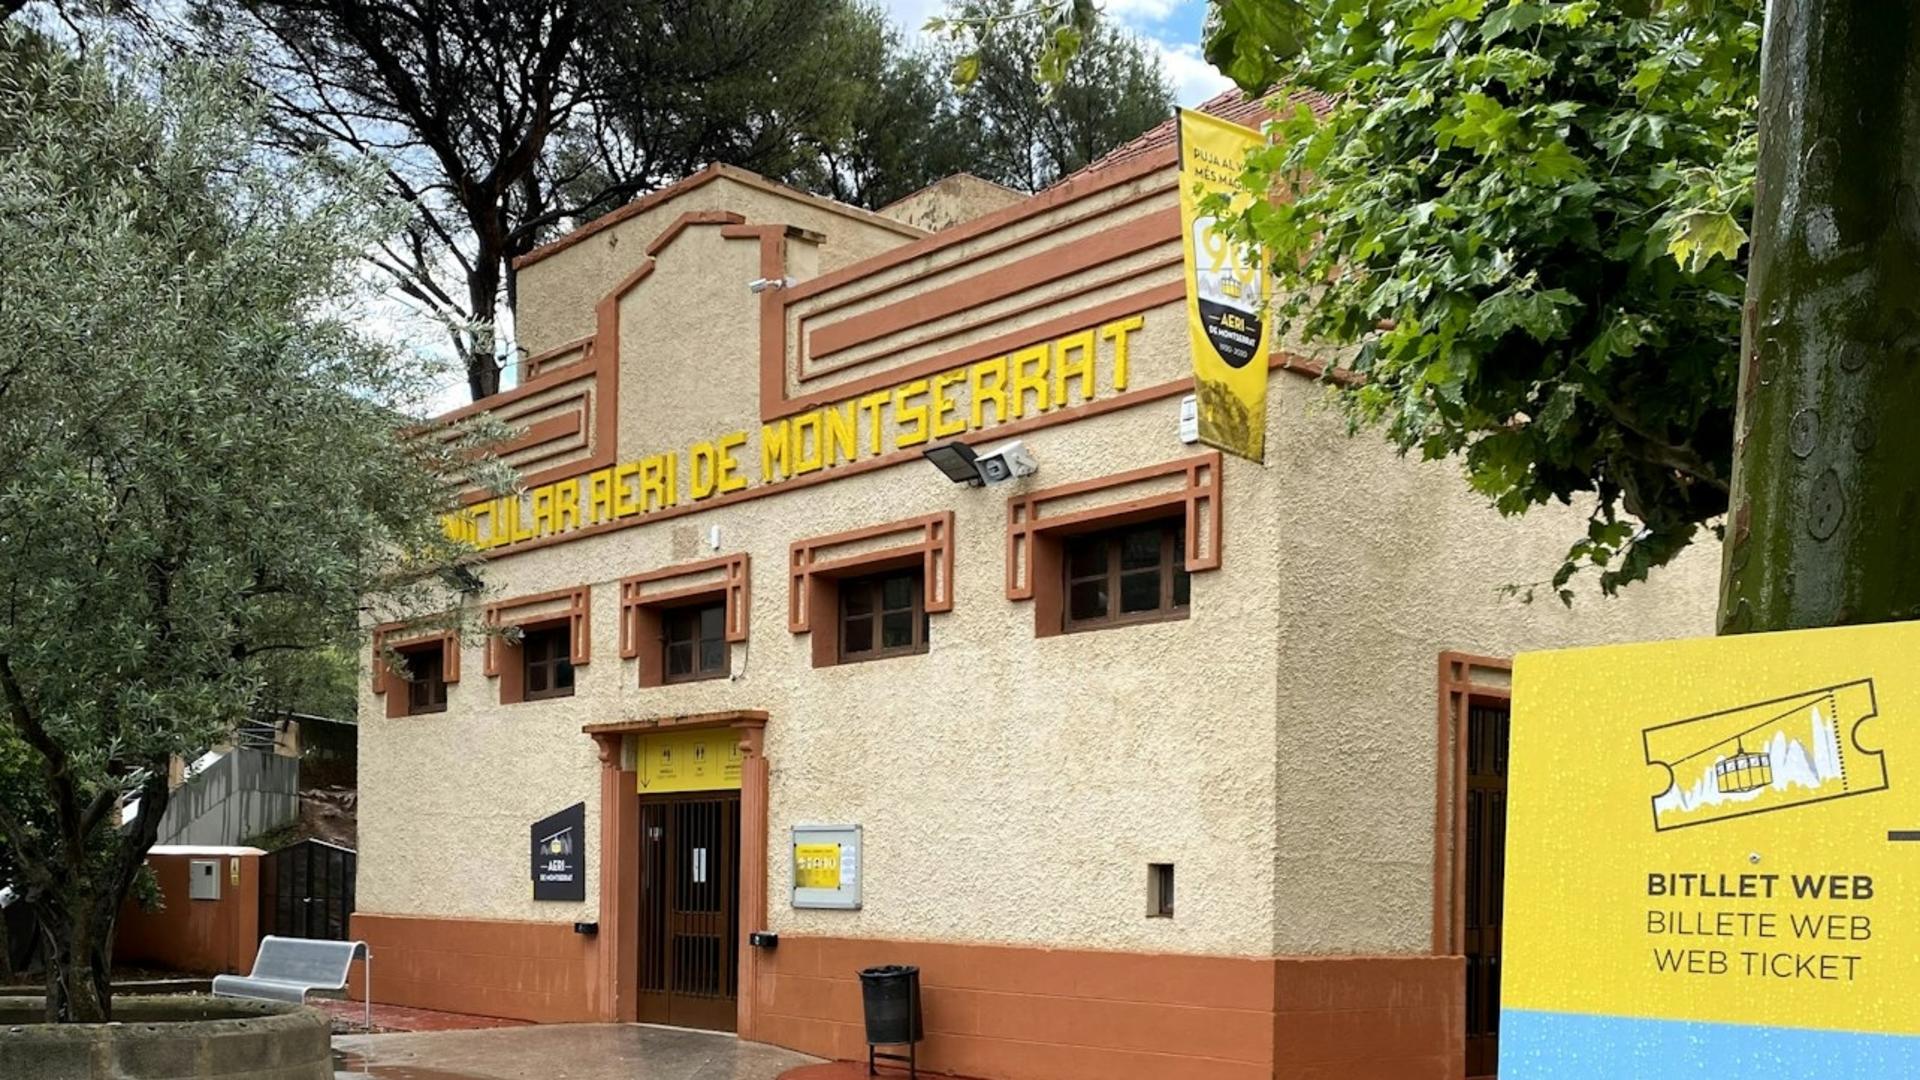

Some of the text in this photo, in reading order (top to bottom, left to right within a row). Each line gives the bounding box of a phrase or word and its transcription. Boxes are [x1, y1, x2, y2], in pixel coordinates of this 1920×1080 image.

[1194, 148, 1220, 167] PUJA
[1222, 159, 1235, 171] AL
[1221, 313, 1245, 332] AERI
[590, 451, 677, 526] AERI
[690, 431, 748, 500] DE
[762, 315, 1144, 483] MONTSERRAT
[548, 860, 565, 871] AERI
[1647, 873, 1874, 900] BITLLET WEB
[1647, 910, 1872, 941] BILLETE WEB
[1654, 948, 1862, 981] WEB TICKET
